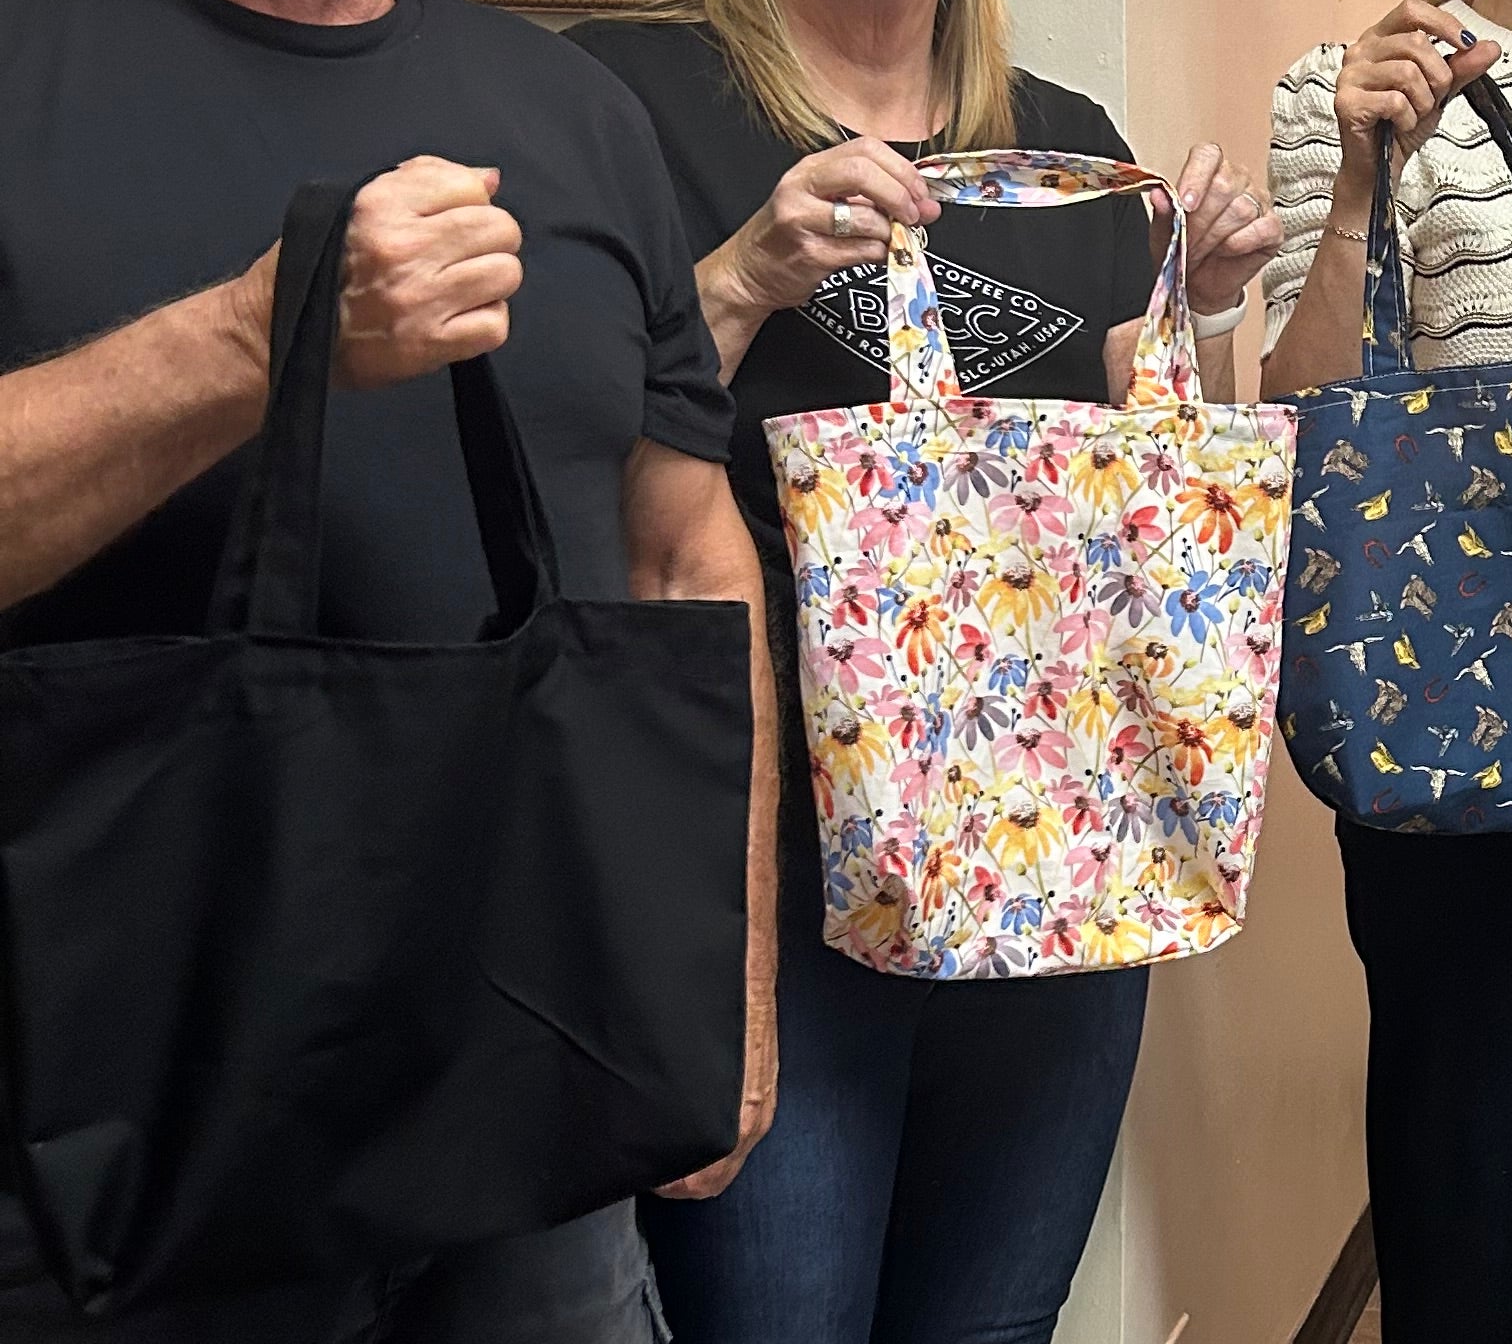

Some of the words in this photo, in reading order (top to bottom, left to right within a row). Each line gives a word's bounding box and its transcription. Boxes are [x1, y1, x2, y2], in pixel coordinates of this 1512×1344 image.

[815, 270, 853, 293] ACK
[932, 264, 1005, 300] COFFEE
[848, 288, 1009, 345] BCC
